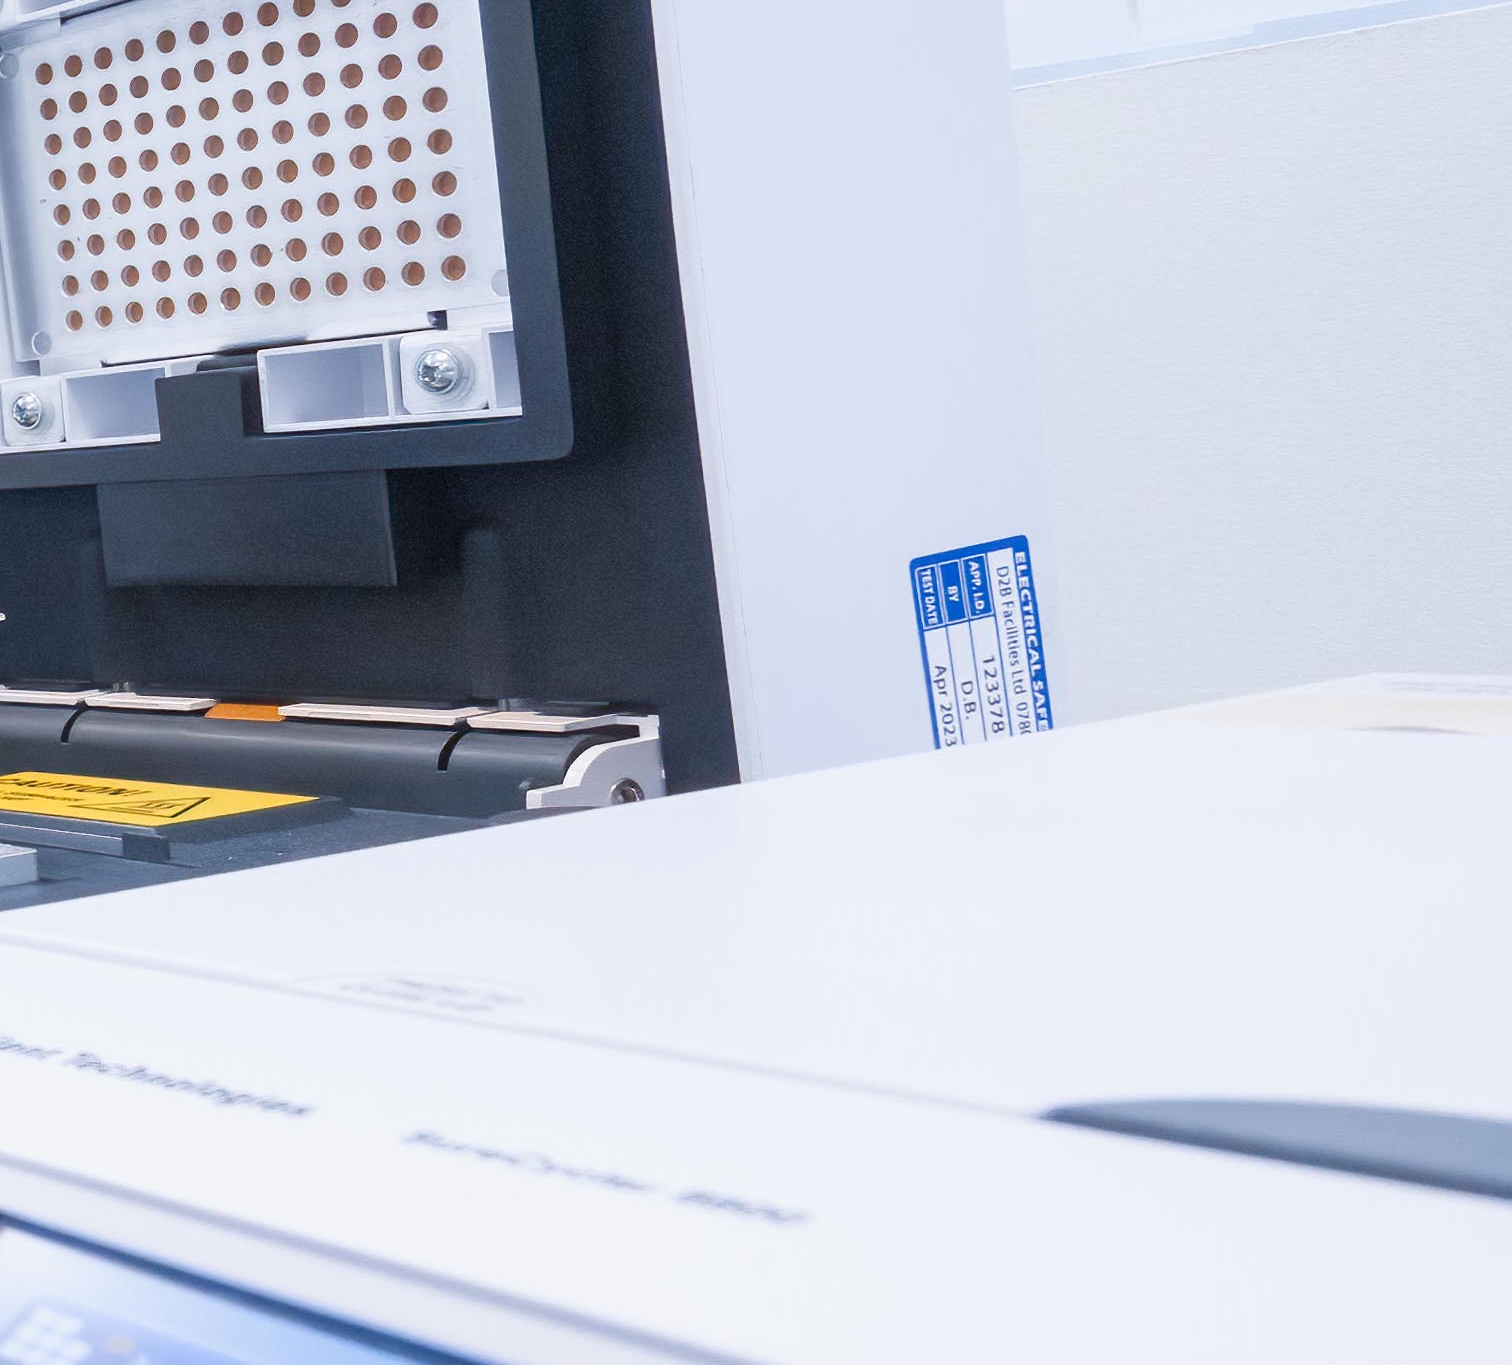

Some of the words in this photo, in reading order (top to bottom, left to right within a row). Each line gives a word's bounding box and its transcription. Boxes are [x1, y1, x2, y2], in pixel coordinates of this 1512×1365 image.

[921, 569, 934, 593] TEST
[996, 566, 1012, 597] D2B
[925, 596, 938, 625] DATE
[1015, 552, 1042, 677] ELECTRICAL
[947, 586, 960, 602] BY
[961, 680, 976, 720] D.B.
[1002, 601, 1020, 667] Facilities
[933, 665, 948, 696] Apr
[983, 654, 1005, 733] 123378
[1012, 670, 1027, 695] Ltd
[940, 702, 957, 747] 2023
[63, 1051, 316, 1116] Technologies
